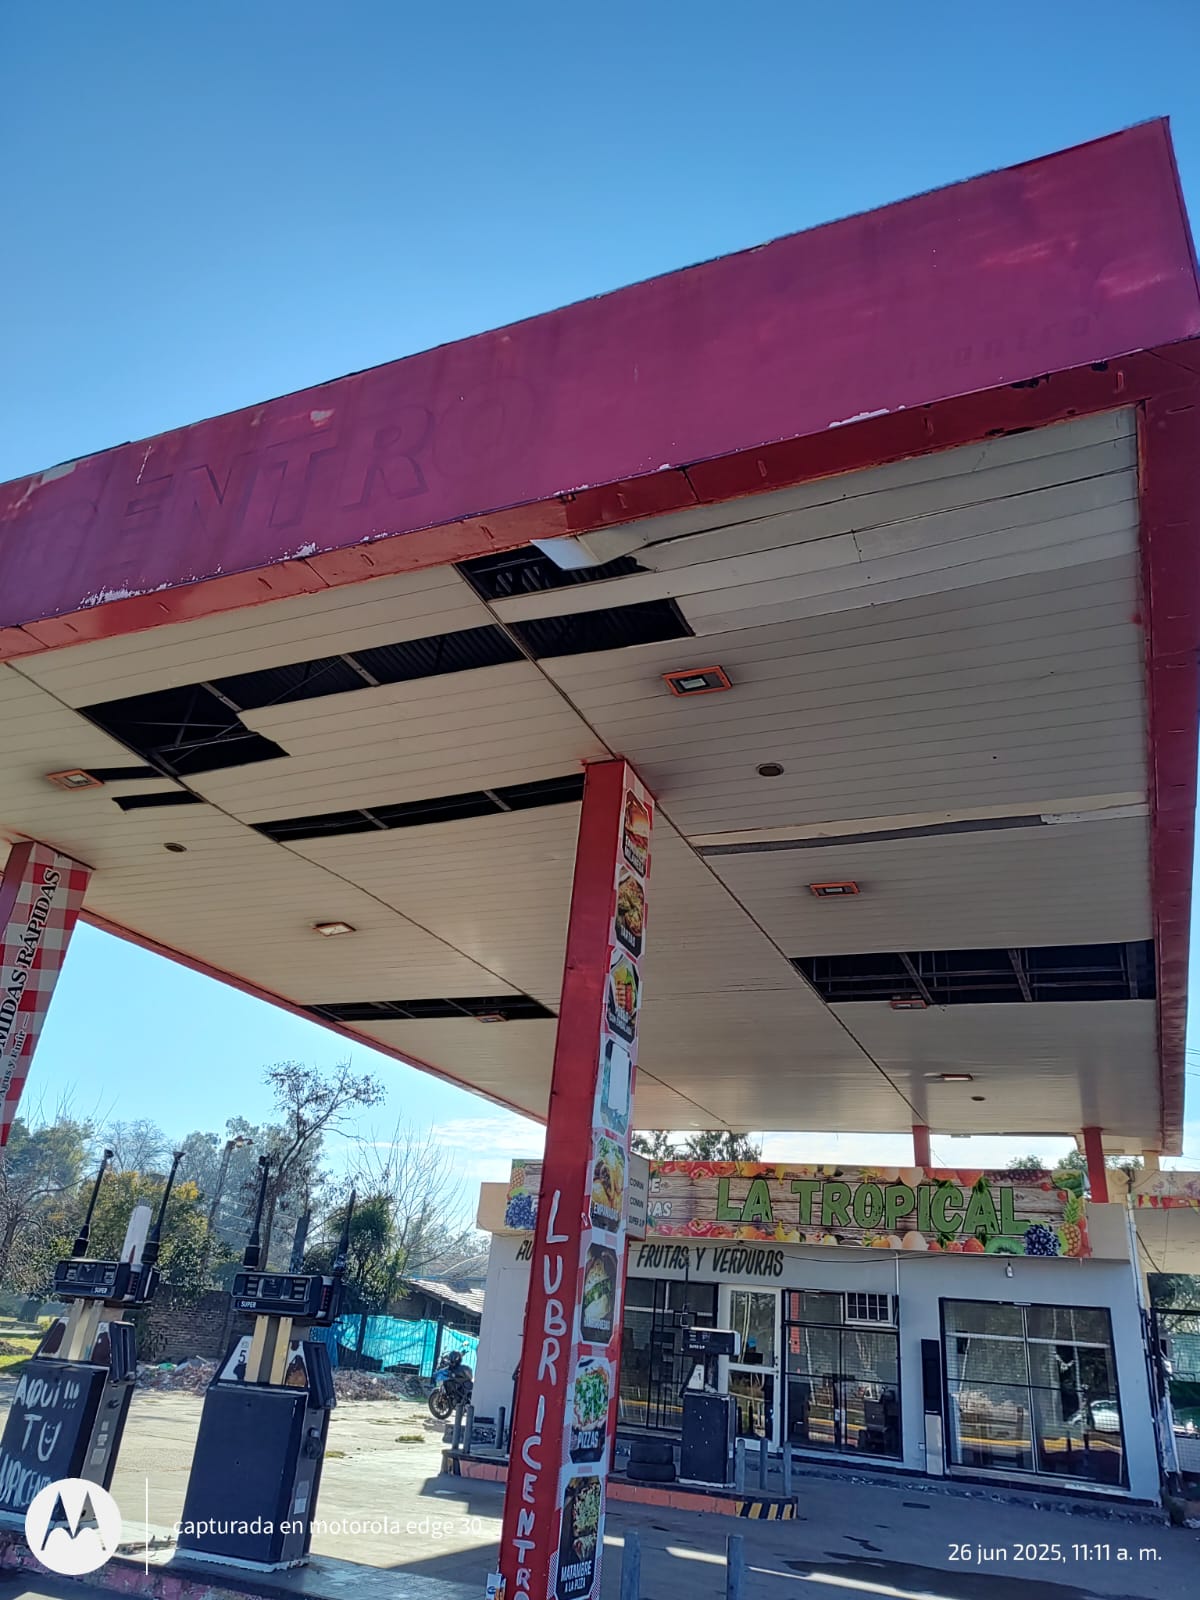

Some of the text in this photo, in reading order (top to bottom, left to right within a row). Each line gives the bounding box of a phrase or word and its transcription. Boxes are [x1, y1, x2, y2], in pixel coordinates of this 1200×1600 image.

[0, 867, 60, 1060] MIDAS RÁPIDAS
[716, 1176, 1031, 1236] LA TROPICAL
[637, 1244, 784, 1277] FRUTAS Y VERDURAS
[238, 1350, 247, 1364] 5
[578, 1431, 599, 1449] PIZZAS
[561, 1561, 592, 1582] MATAMBRE
